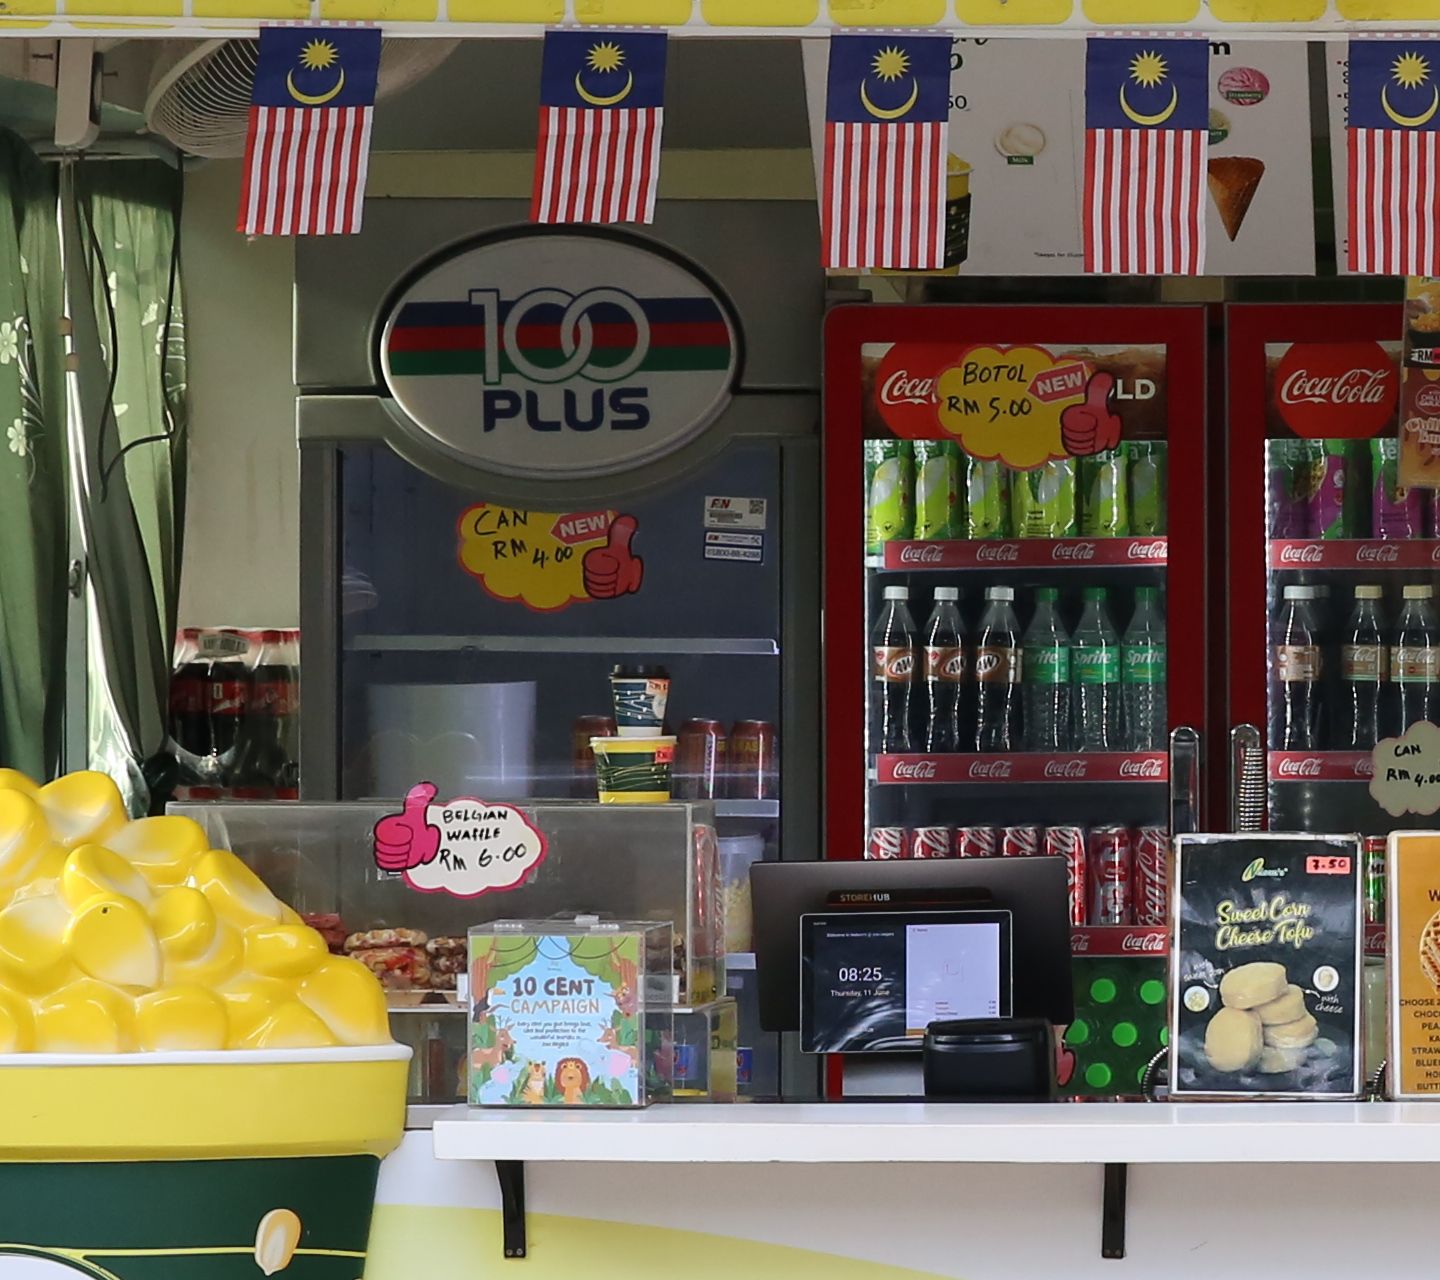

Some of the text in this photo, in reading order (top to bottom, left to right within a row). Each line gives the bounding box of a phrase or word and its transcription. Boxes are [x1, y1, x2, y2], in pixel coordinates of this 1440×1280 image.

[469, 286, 650, 384] 100
[1418, 350, 1432, 361] RM
[963, 362, 1027, 385] BOTOL
[1037, 371, 1084, 395] NEW
[1281, 369, 1390, 405] Coca-Cola
[483, 387, 649, 433] PLUS
[947, 397, 1031, 422] RM 5.00
[474, 511, 527, 535] CAN
[560, 516, 606, 537] NEW
[493, 539, 572, 568] RM 4.00
[1074, 650, 1110, 666] Sprite
[1394, 744, 1421, 757] CAN
[1387, 768, 1410, 781] RM
[443, 809, 507, 824] BELGIAN
[440, 843, 527, 871] RM 6.00
[1312, 859, 1347, 870] 7.50
[1217, 895, 1310, 925] Sweet Corn
[1216, 921, 1313, 950] Cheese Tofu
[839, 968, 882, 982] 08:25
[513, 976, 595, 996] 10 CENT
[831, 989, 862, 997] Thursday,
[511, 999, 599, 1014] CAMPAIGN
[1315, 1003, 1343, 1014] cheese
